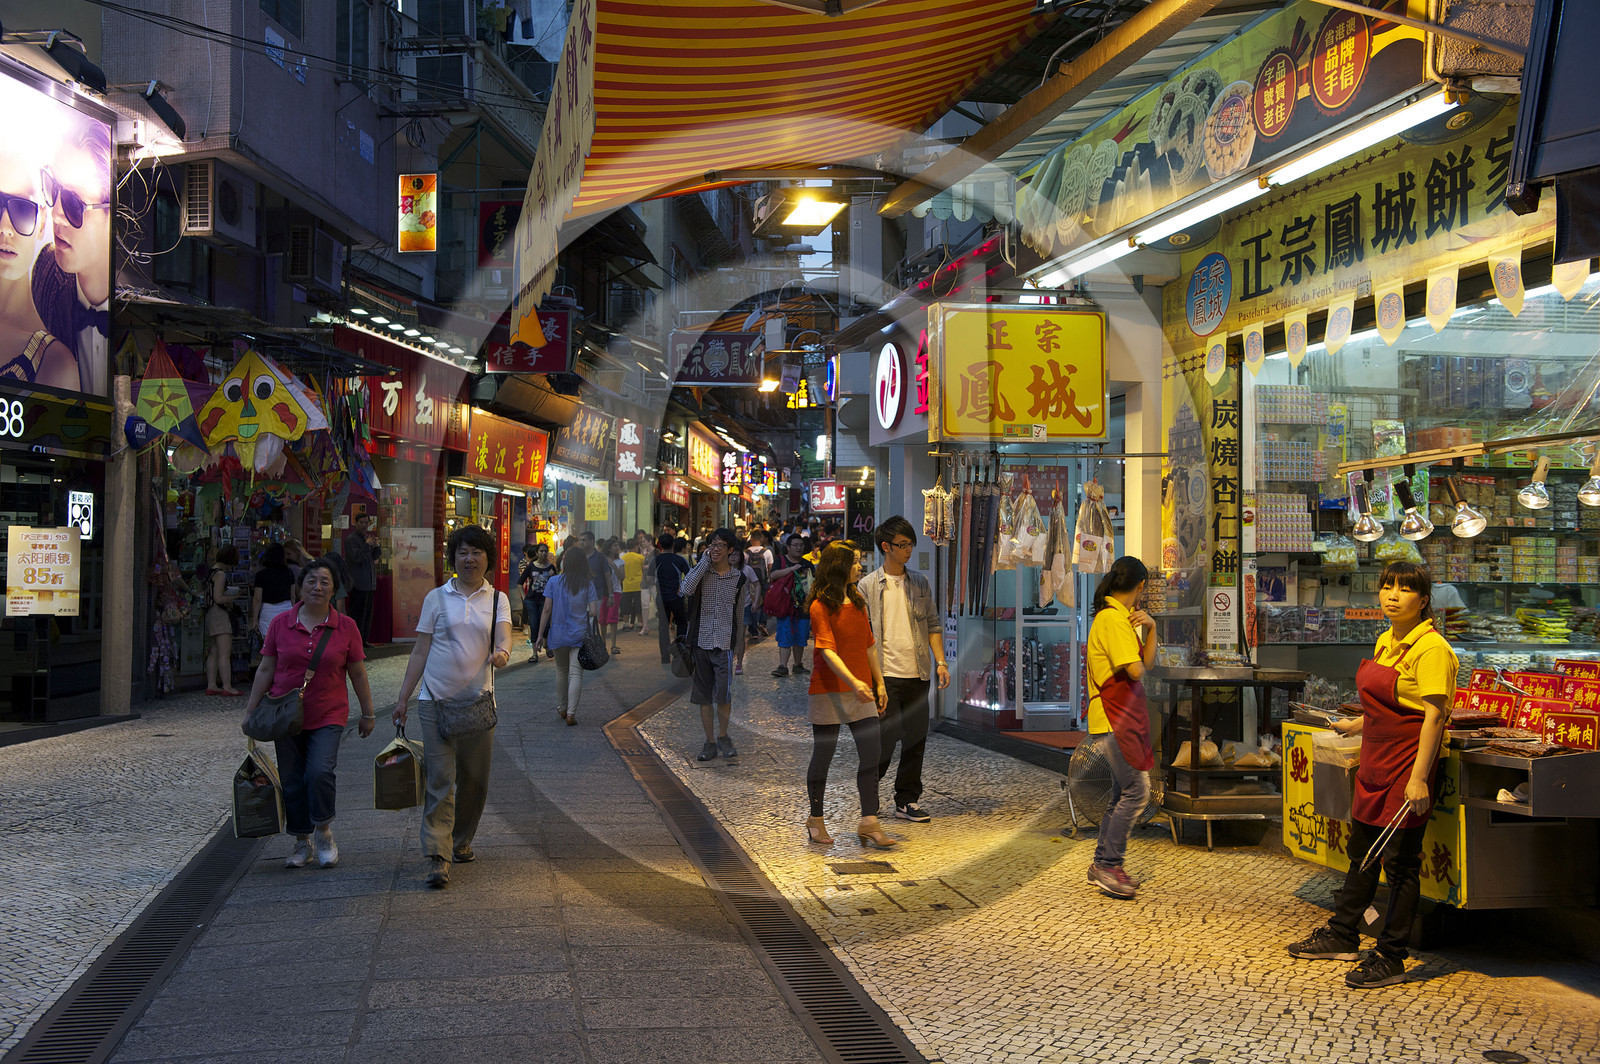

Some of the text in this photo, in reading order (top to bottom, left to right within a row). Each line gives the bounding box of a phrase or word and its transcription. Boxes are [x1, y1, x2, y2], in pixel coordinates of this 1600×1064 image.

[1324, 38, 1355, 71] 品牌
[1324, 62, 1354, 97] 手信
[1193, 259, 1226, 298] 正宗
[1192, 289, 1224, 327] 鳳城
[1238, 306, 1270, 322] Pastelaria
[1301, 292, 1310, 304] da
[984, 319, 1063, 354] 正宗
[956, 358, 1092, 428] 鳳城
[475, 432, 542, 484] 濠江手信
[618, 422, 641, 476] 鳳城
[1210, 399, 1238, 572] 炭燒杏仁餅
[852, 513, 874, 532] 40
[18, 552, 70, 564] 太阳眼镜
